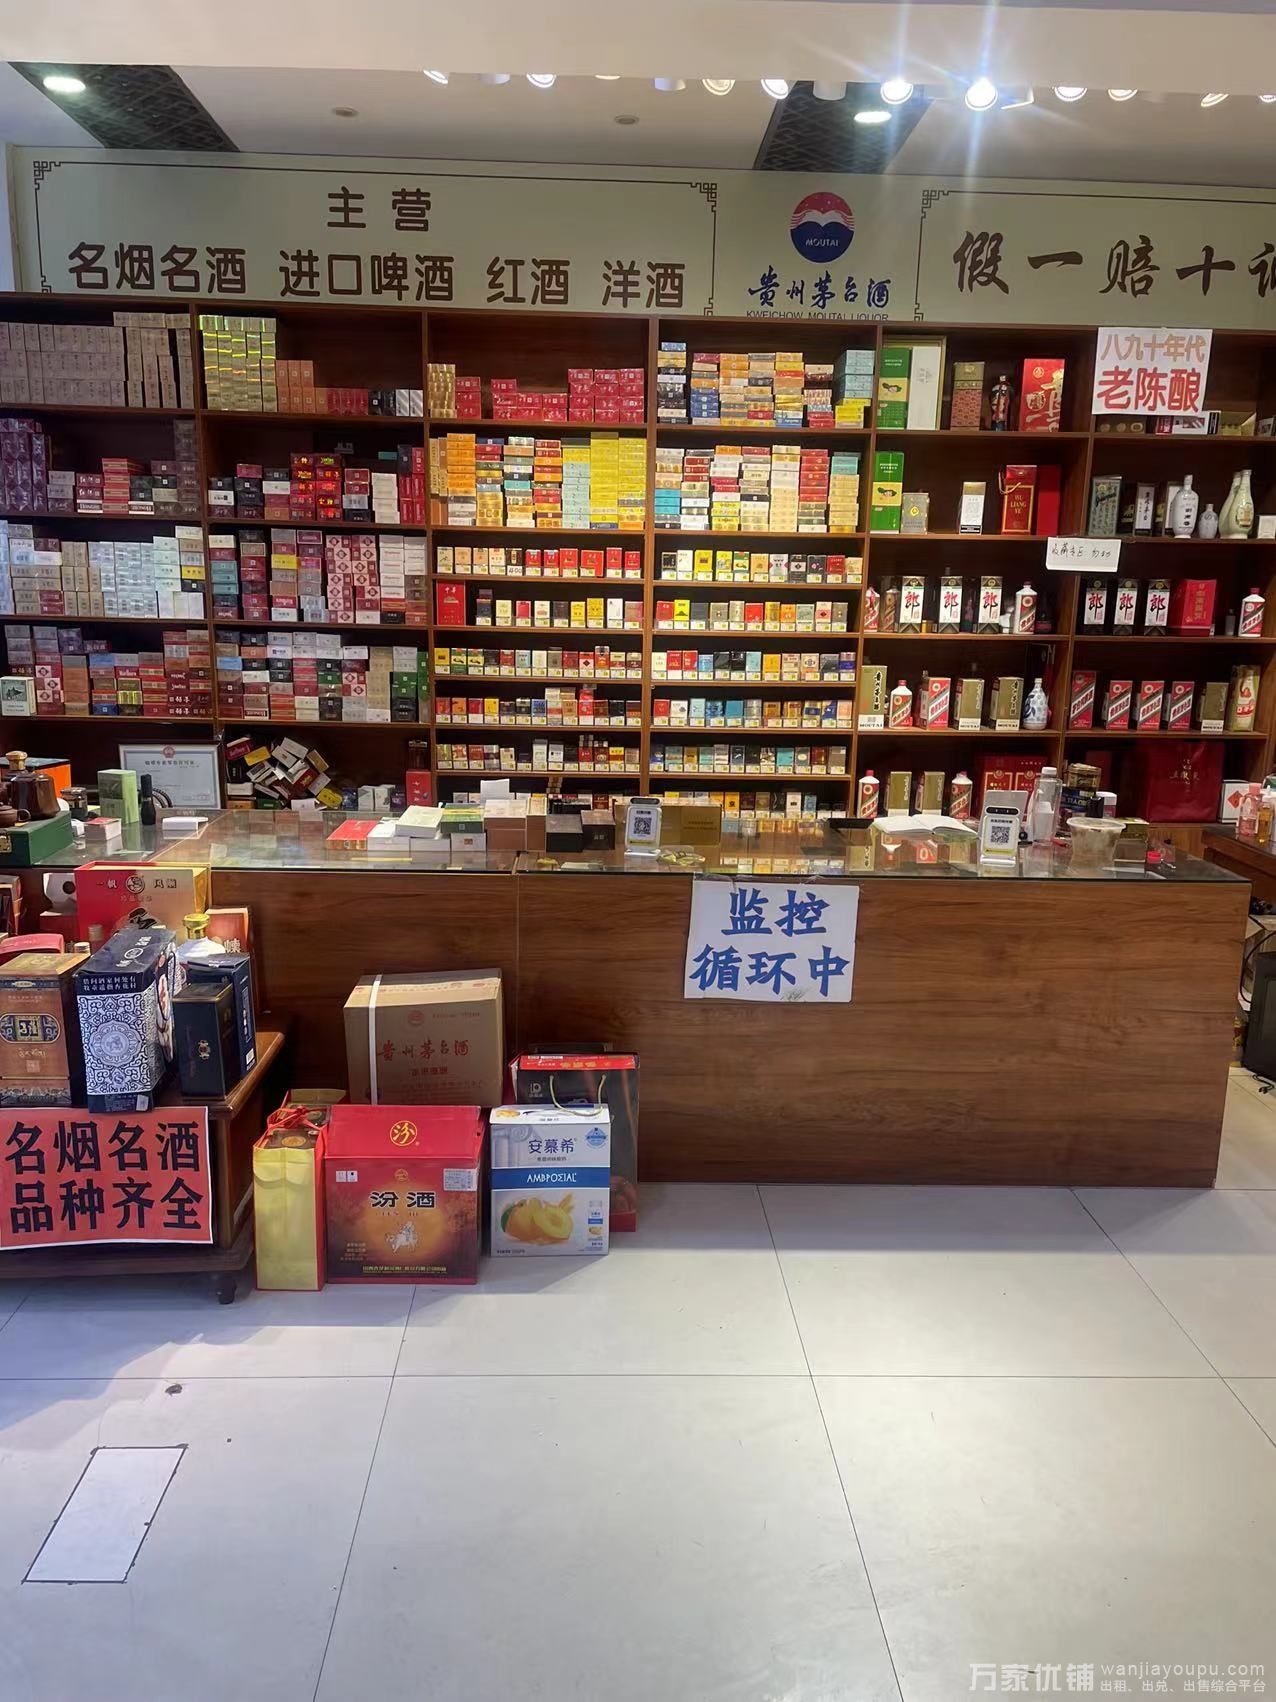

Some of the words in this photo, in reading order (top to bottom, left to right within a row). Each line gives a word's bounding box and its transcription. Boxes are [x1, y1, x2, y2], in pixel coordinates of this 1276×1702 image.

[328, 185, 432, 233] 主营
[805, 238, 839, 247] MOUTAI
[67, 240, 247, 295] 名烟名酒
[279, 249, 454, 303] 进口啤酒
[486, 257, 570, 306] 红酒
[601, 259, 686, 310] 洋酒
[1099, 333, 1207, 363] 八九十年代
[1097, 364, 1202, 414] 老陈酿
[721, 888, 830, 938] 监控
[689, 943, 851, 998] 循环中
[5, 1120, 200, 1175] 名烟名酒
[528, 1138, 575, 1154] 安慕希
[10, 1176, 204, 1234] 品种齐全
[369, 1190, 437, 1210] 汾酒
